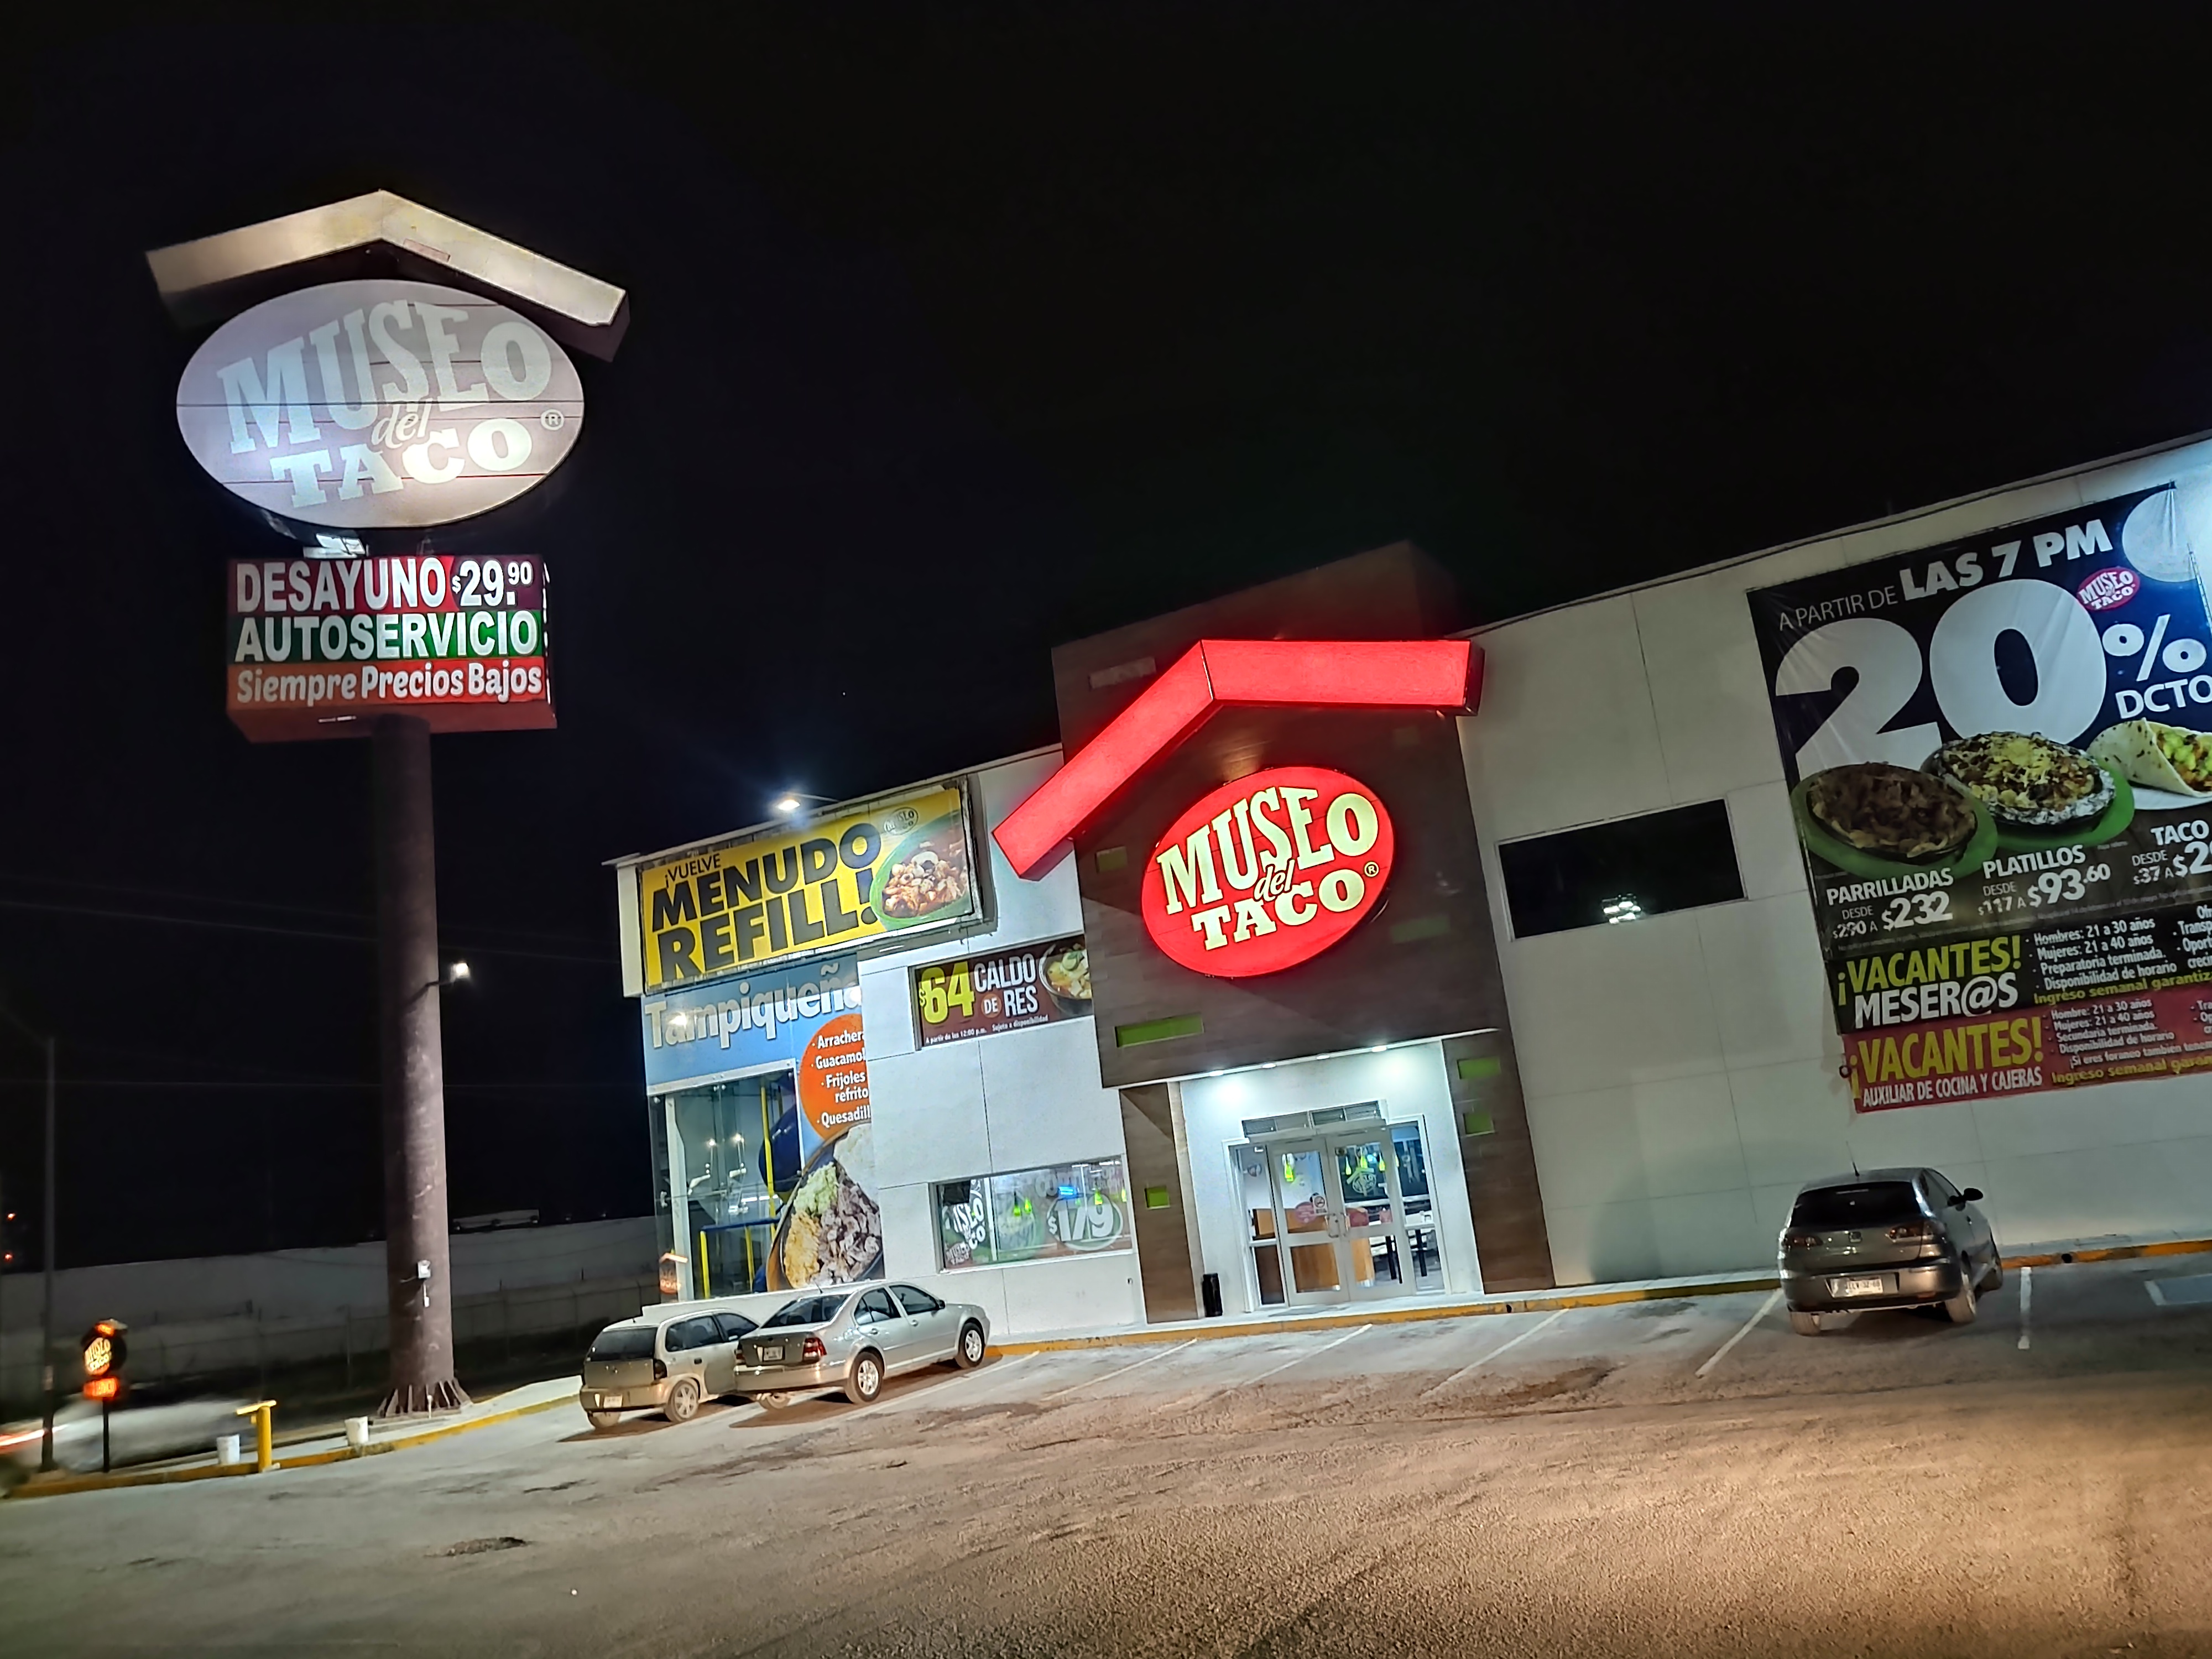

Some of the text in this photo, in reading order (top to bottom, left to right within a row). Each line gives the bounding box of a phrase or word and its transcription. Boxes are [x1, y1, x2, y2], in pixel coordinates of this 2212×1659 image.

[216, 299, 551, 454] MUSEO
[372, 398, 432, 448] del
[270, 418, 533, 508] TACO
[236, 557, 446, 613] DESAYUNO
[1778, 518, 2114, 632] A PARTIR DE LAS 7 PM
[2079, 571, 2133, 604] MUSEO
[2091, 586, 2133, 609] TACO
[235, 611, 539, 662] AUTOSERVICIO
[237, 660, 542, 707] Siempre Precios Bajos
[2115, 674, 2212, 719] DCTO
[1156, 786, 1379, 915] MUSEO
[2150, 820, 2210, 846] TACO
[665, 853, 721, 889] ¡VUELVE
[1983, 844, 2086, 879] PLATILLOS
[2132, 849, 2168, 867] DESDE
[2165, 867, 2174, 879] A
[2173, 841, 2212, 878] $2
[652, 823, 881, 932] MENUDO
[1254, 859, 1295, 901] del
[1827, 868, 1954, 906] PARRILLADAS
[1983, 881, 2017, 897] DESDE
[2018, 896, 2027, 909] A
[2027, 863, 2111, 908] $93.60
[657, 867, 878, 983] REFILL!
[1191, 869, 1365, 951] TACO
[1842, 905, 1874, 920] DESDE
[1870, 921, 1878, 932] A
[1881, 891, 1954, 931] $232
[2034, 916, 2156, 946] Hombres: 21 a 30 años
[2037, 933, 2154, 963] Mujeres: 21 a 40 años
[1838, 935, 2022, 1006] ¡VACANTES!
[2041, 946, 2167, 977] Preparatoria terminada.
[2044, 959, 2178, 992] Disponibilidad de horario
[919, 953, 1036, 1024] $64 CALDO
[984, 985, 1039, 1018] DE RES
[1855, 972, 2018, 1029] MESER@S
[2034, 989, 2086, 1006] Ingreso
[2089, 977, 2148, 997] semanal
[2092, 1004, 2104, 1014] 21
[2115, 1001, 2128, 1011] 30
[2130, 998, 2152, 1009] años
[2056, 1027, 2106, 1043] Secundaria
[2095, 1015, 2106, 1026] 21
[2117, 1012, 2130, 1022] 40
[2132, 1009, 2155, 1020] años
[1850, 1016, 2044, 1100] ¡VACANTES!
[2059, 1030, 2174, 1055] Disponibilidad de horario
[826, 1071, 866, 1091] Frijoles
[1863, 1066, 2043, 1108] AUXILIAR DE COCINA Y CAJERAS
[2051, 1069, 2104, 1086] Ingreso
[2107, 1058, 2167, 1077] semanal
